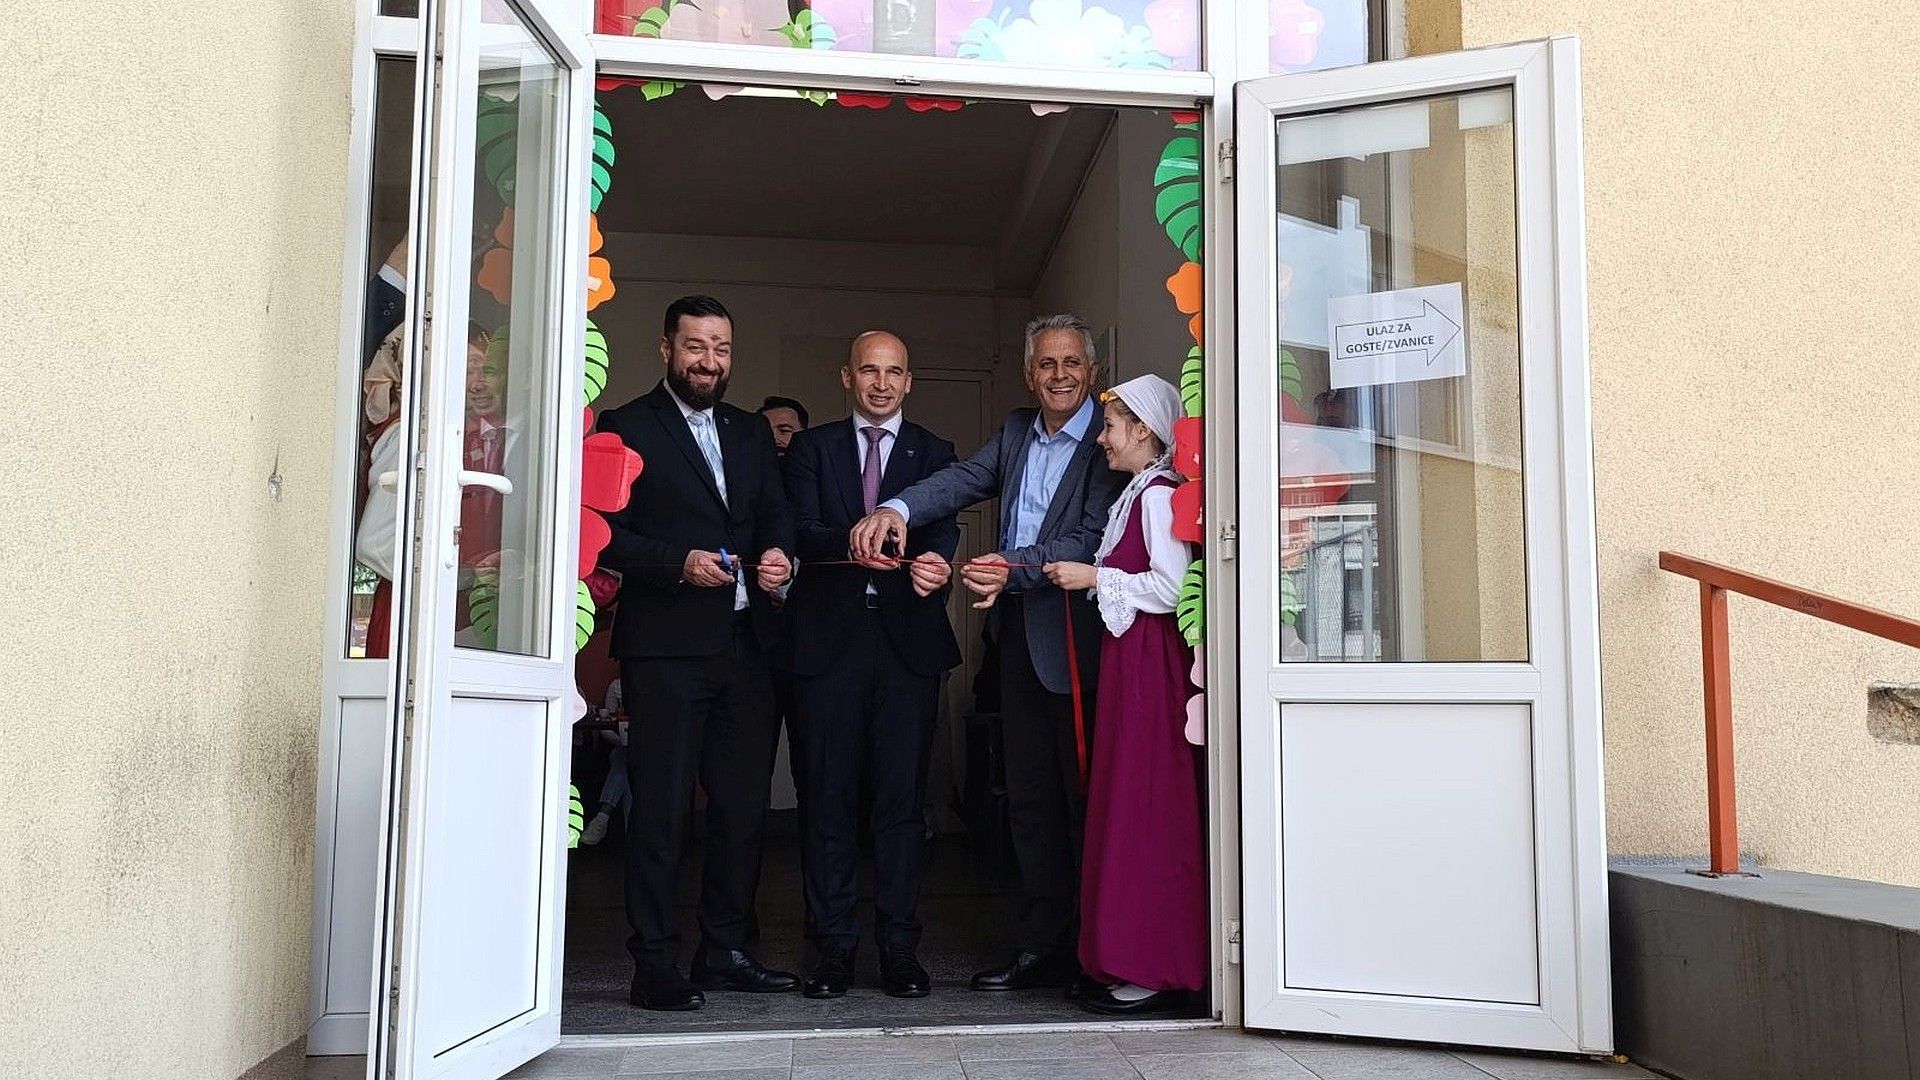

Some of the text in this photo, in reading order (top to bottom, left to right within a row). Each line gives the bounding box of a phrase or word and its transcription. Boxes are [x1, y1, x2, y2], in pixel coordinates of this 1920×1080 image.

[1366, 323, 1412, 337] ULAZ ZA
[1346, 335, 1434, 354] GOSTE/ZVANICE
